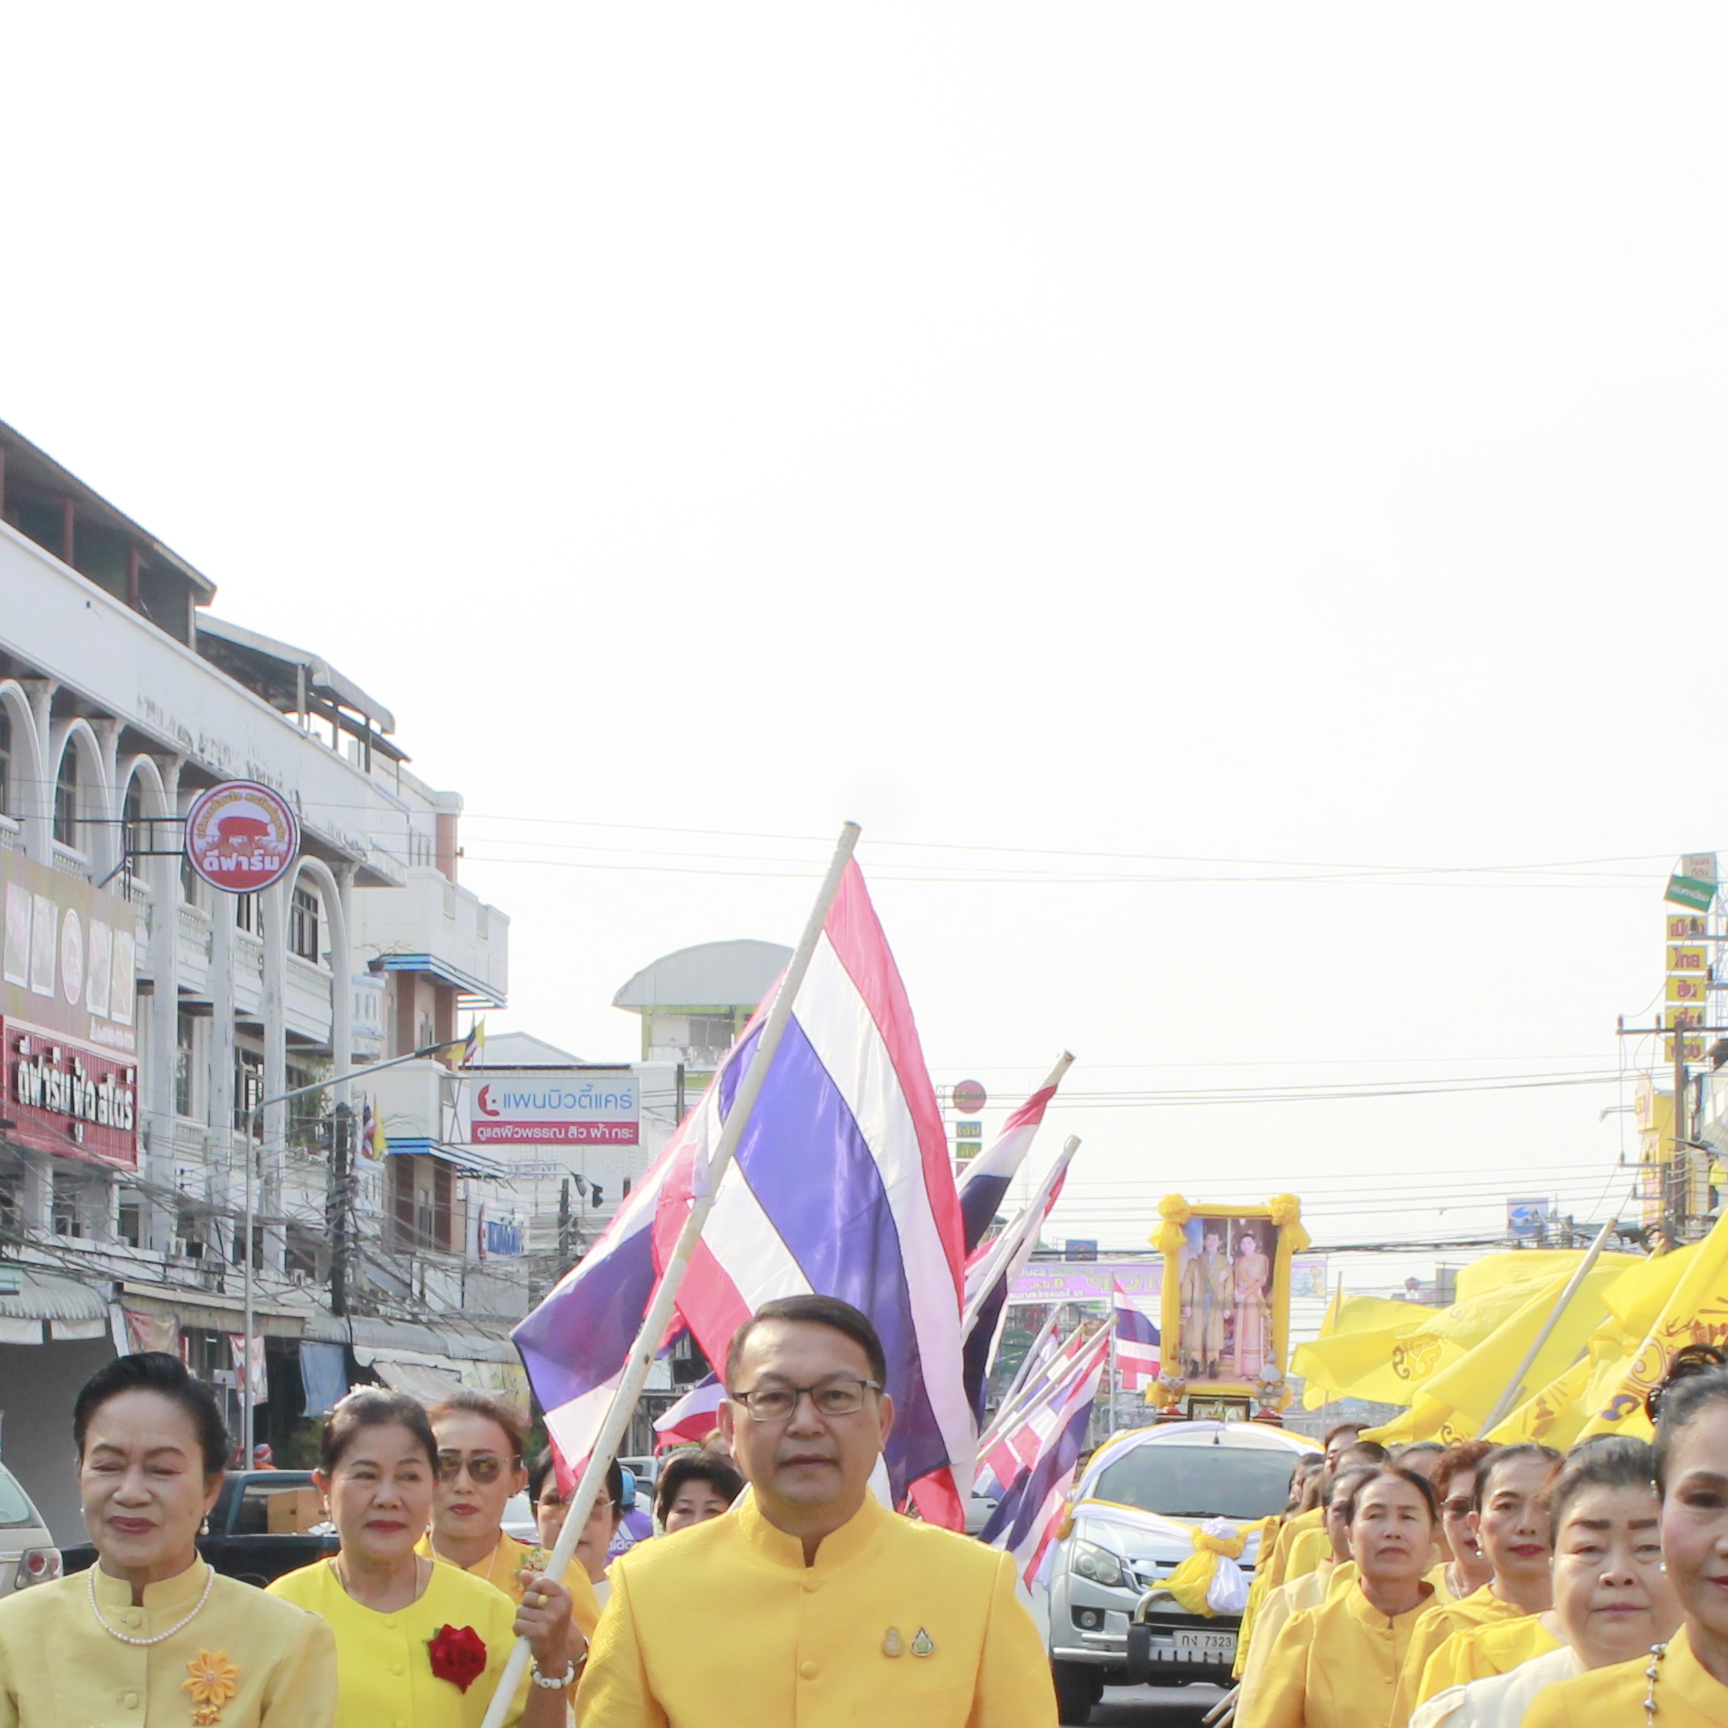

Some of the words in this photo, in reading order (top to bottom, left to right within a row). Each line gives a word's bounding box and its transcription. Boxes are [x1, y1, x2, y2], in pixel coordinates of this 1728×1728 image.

[203, 849, 280, 872] ดีฟาร์ม
[503, 1083, 633, 1110] แพนบิวตี้แคร์
[477, 1125, 565, 1142] ดูแลผิวพรรณ
[567, 1126, 587, 1139] สิว
[591, 1123, 609, 1139] ฝ้า
[612, 1127, 634, 1139] กระ
[1205, 1636, 1232, 1647] 7323
